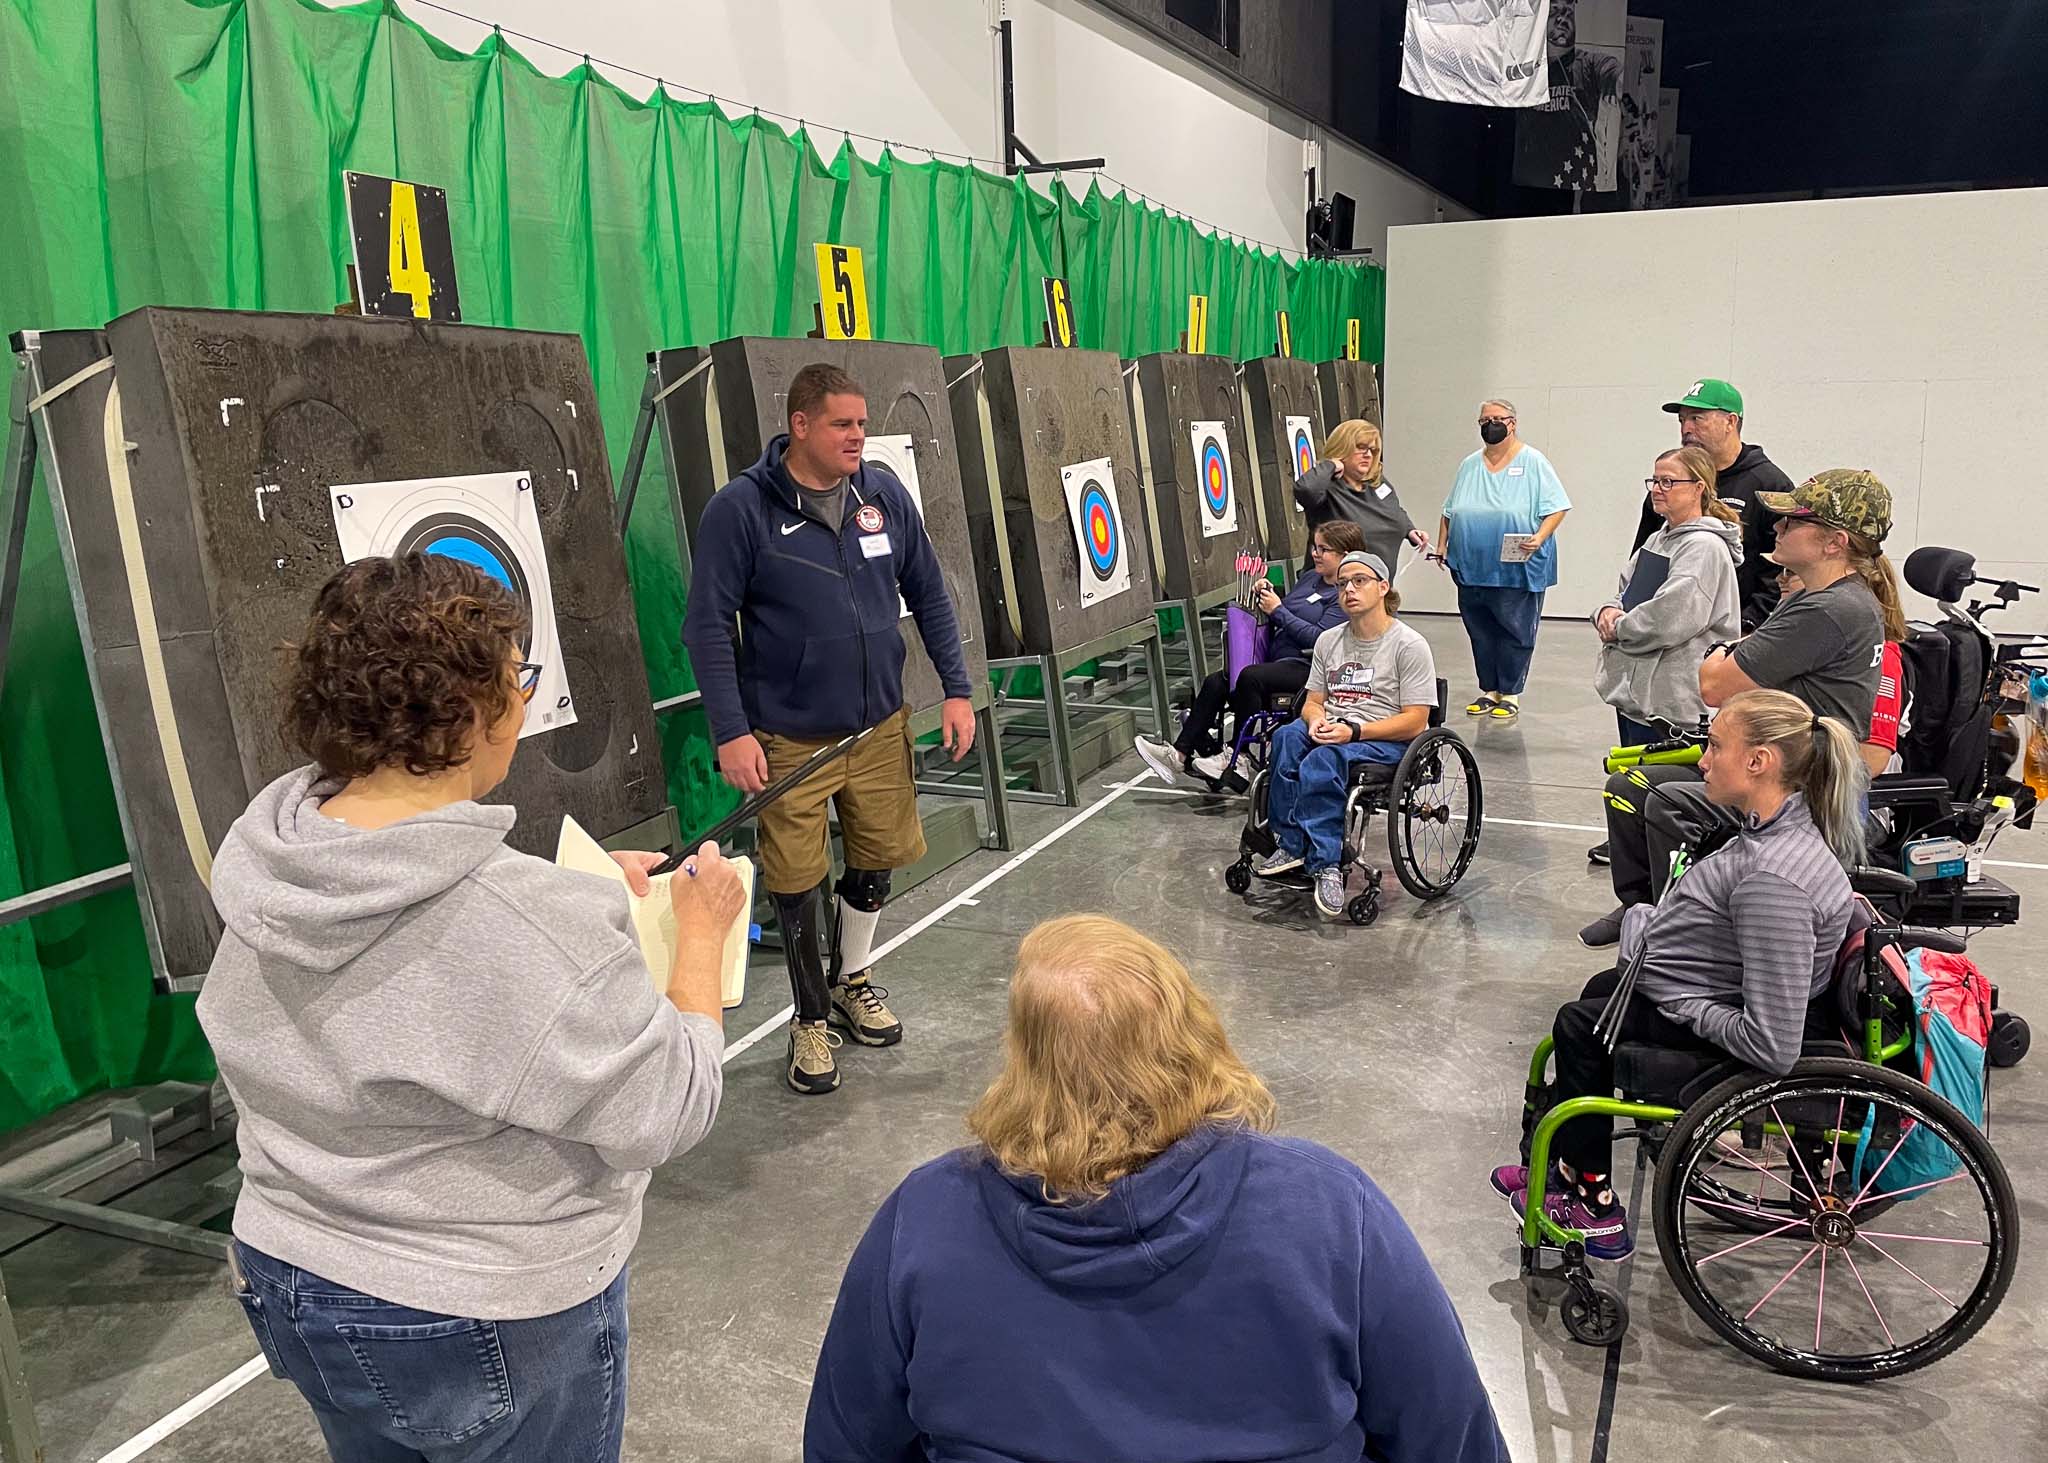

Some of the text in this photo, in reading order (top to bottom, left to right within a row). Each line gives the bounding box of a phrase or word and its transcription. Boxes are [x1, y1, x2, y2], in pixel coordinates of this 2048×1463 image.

[1549, 85, 1577, 98] TATES
[388, 181, 432, 319] 4
[831, 247, 856, 338] 5
[1053, 279, 1071, 348] 6
[1351, 320, 1358, 360] 9
[1685, 382, 1705, 397] M
[1692, 1080, 1782, 1140] SPINERGY
[1585, 1226, 1622, 1235] salomon
